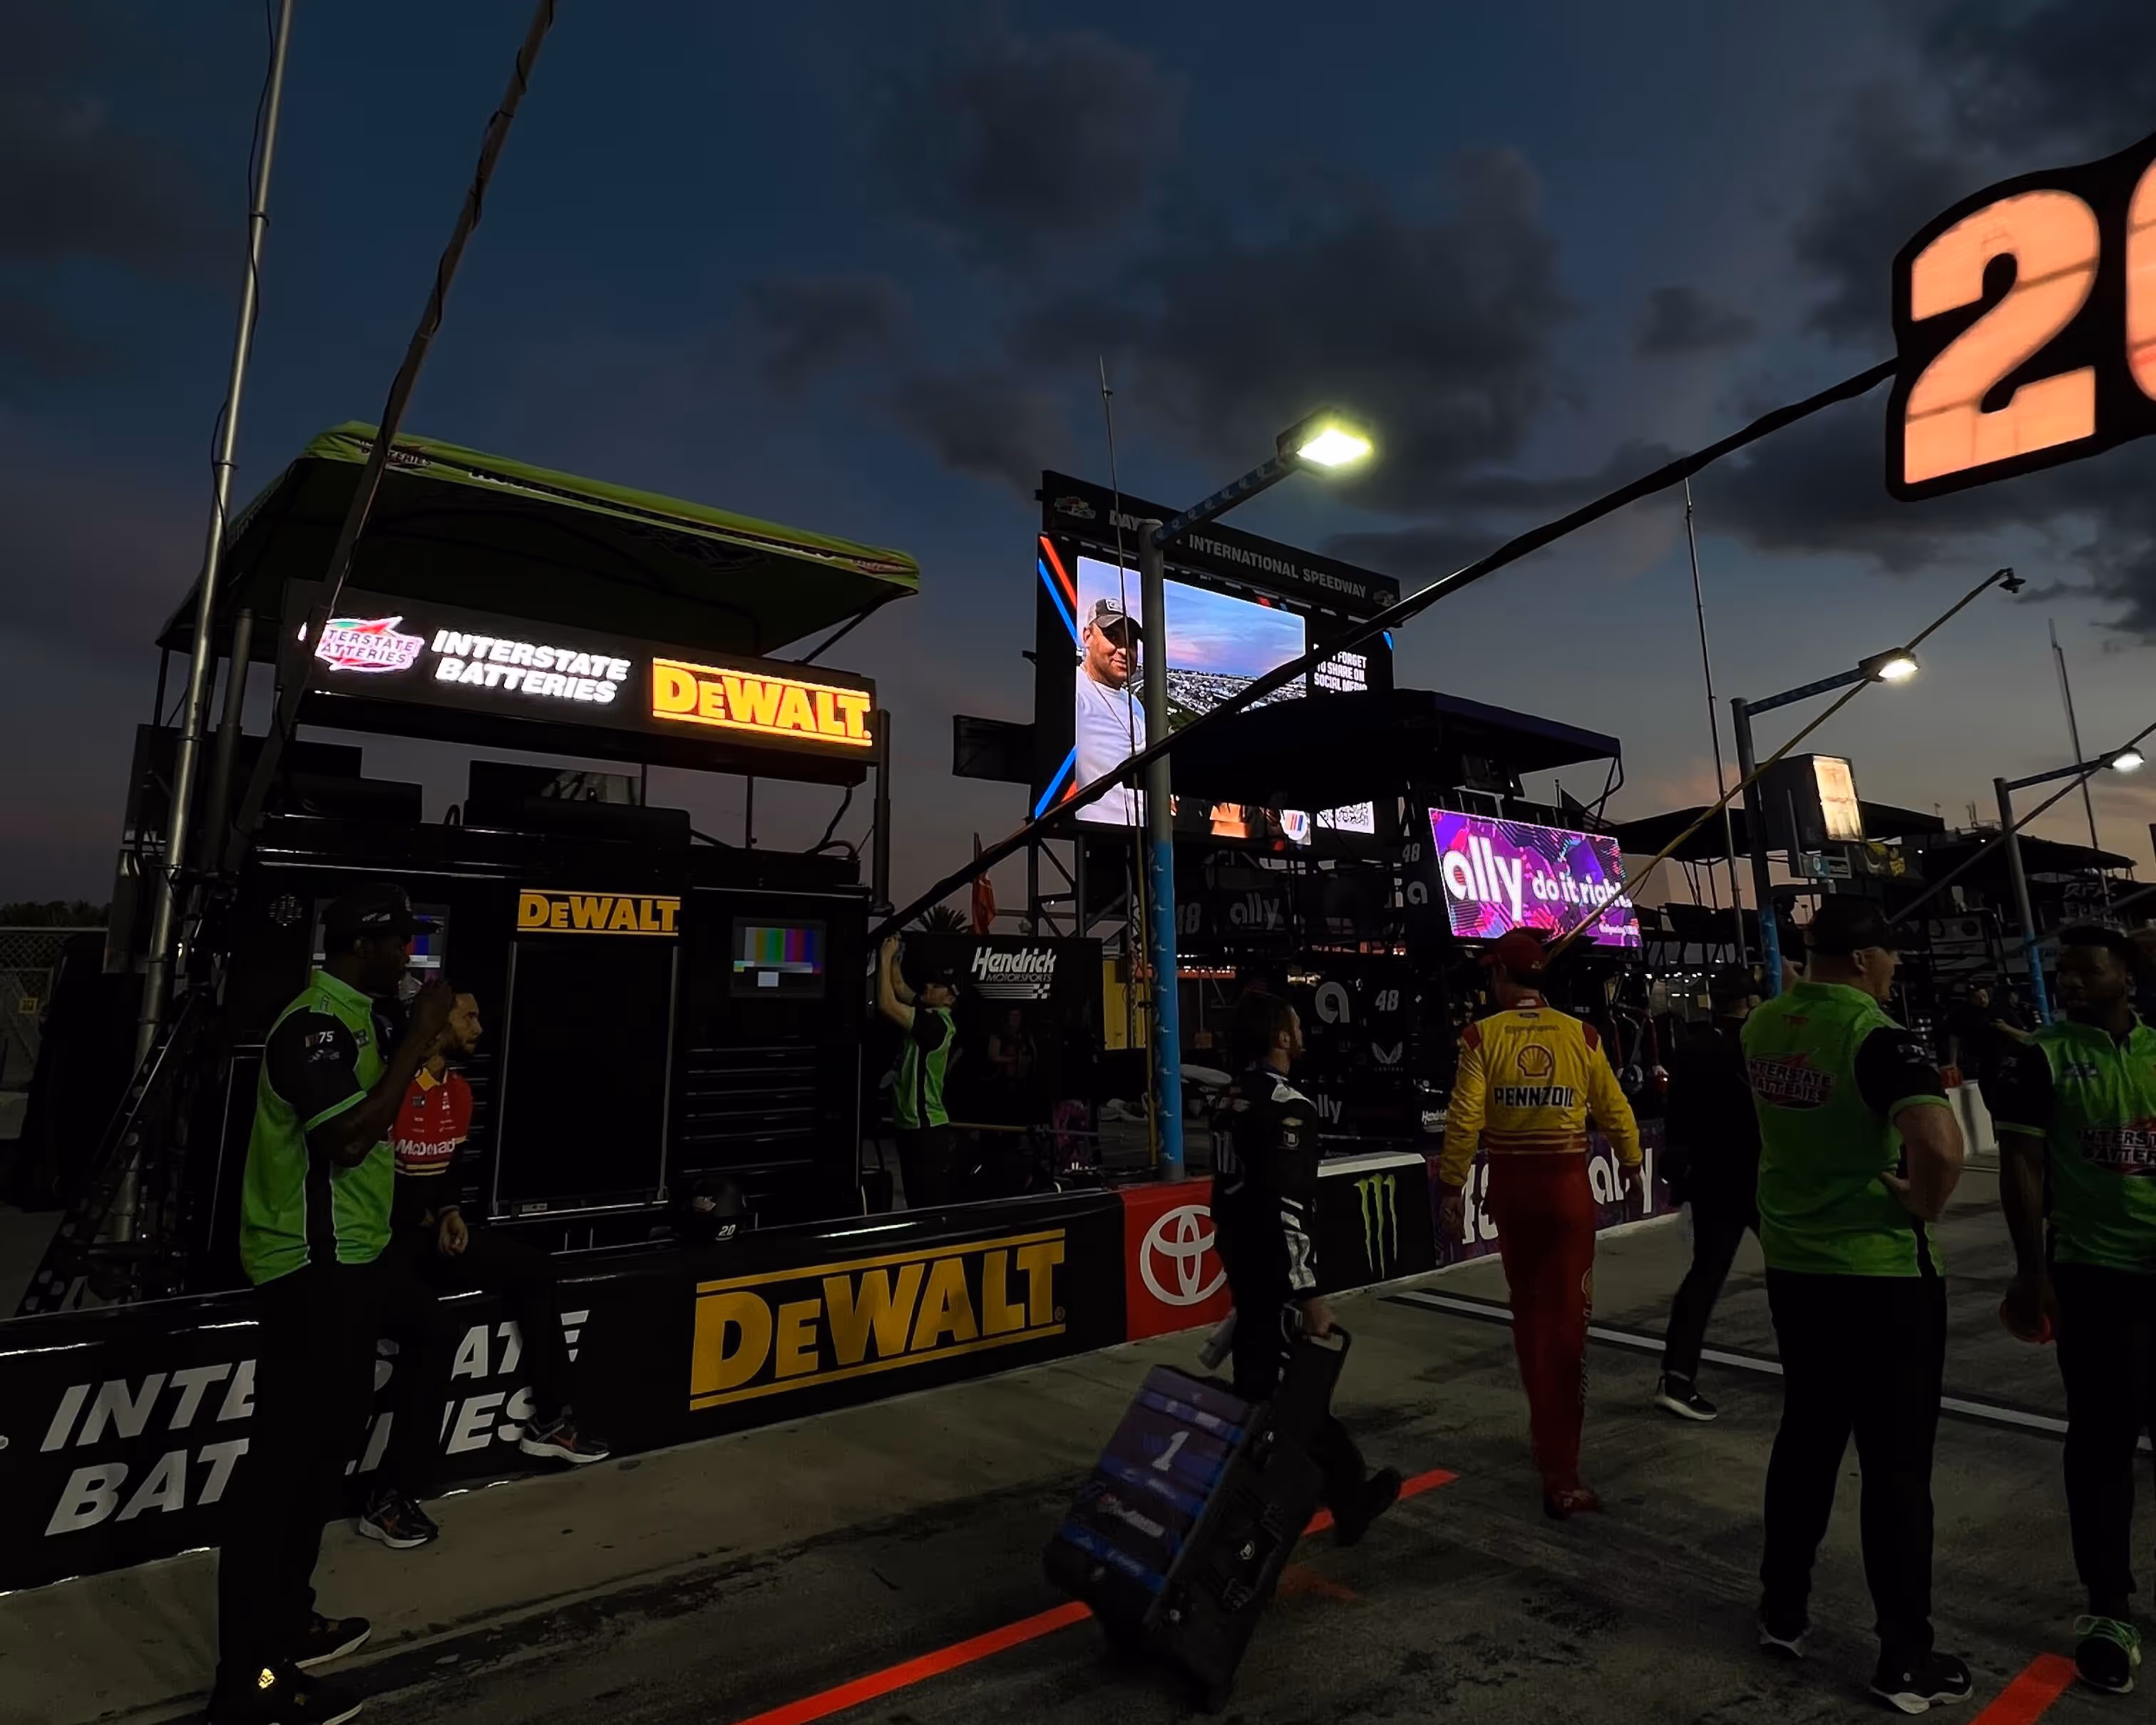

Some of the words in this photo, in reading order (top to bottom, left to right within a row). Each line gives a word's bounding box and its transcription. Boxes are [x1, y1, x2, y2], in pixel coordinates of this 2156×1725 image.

[1189, 533, 1299, 579] INTERNATIONAL
[1303, 568, 1367, 598] SPEEDWAY
[321, 643, 407, 663] ATTERIES
[431, 629, 632, 681] INTERSTATE
[434, 656, 618, 703] BATTERIES
[1314, 672, 1341, 691] SOCIAL
[1327, 662, 1353, 680] SHARE
[1353, 668, 1365, 682] ON
[1402, 841, 1421, 863] 48
[1442, 835, 1522, 921] ally
[1532, 869, 1559, 901] do
[1559, 871, 1579, 904] it
[1229, 891, 1280, 931] ally
[970, 946, 1057, 981] Hendrick
[986, 973, 1052, 983] MOTORSPORTS
[1375, 989, 1400, 1012] 48
[319, 1030, 335, 1043] 75
[1494, 1087, 1574, 1107] PENNZOIL
[718, 1224, 736, 1237] 20
[1151, 1430, 1191, 1472] 1
